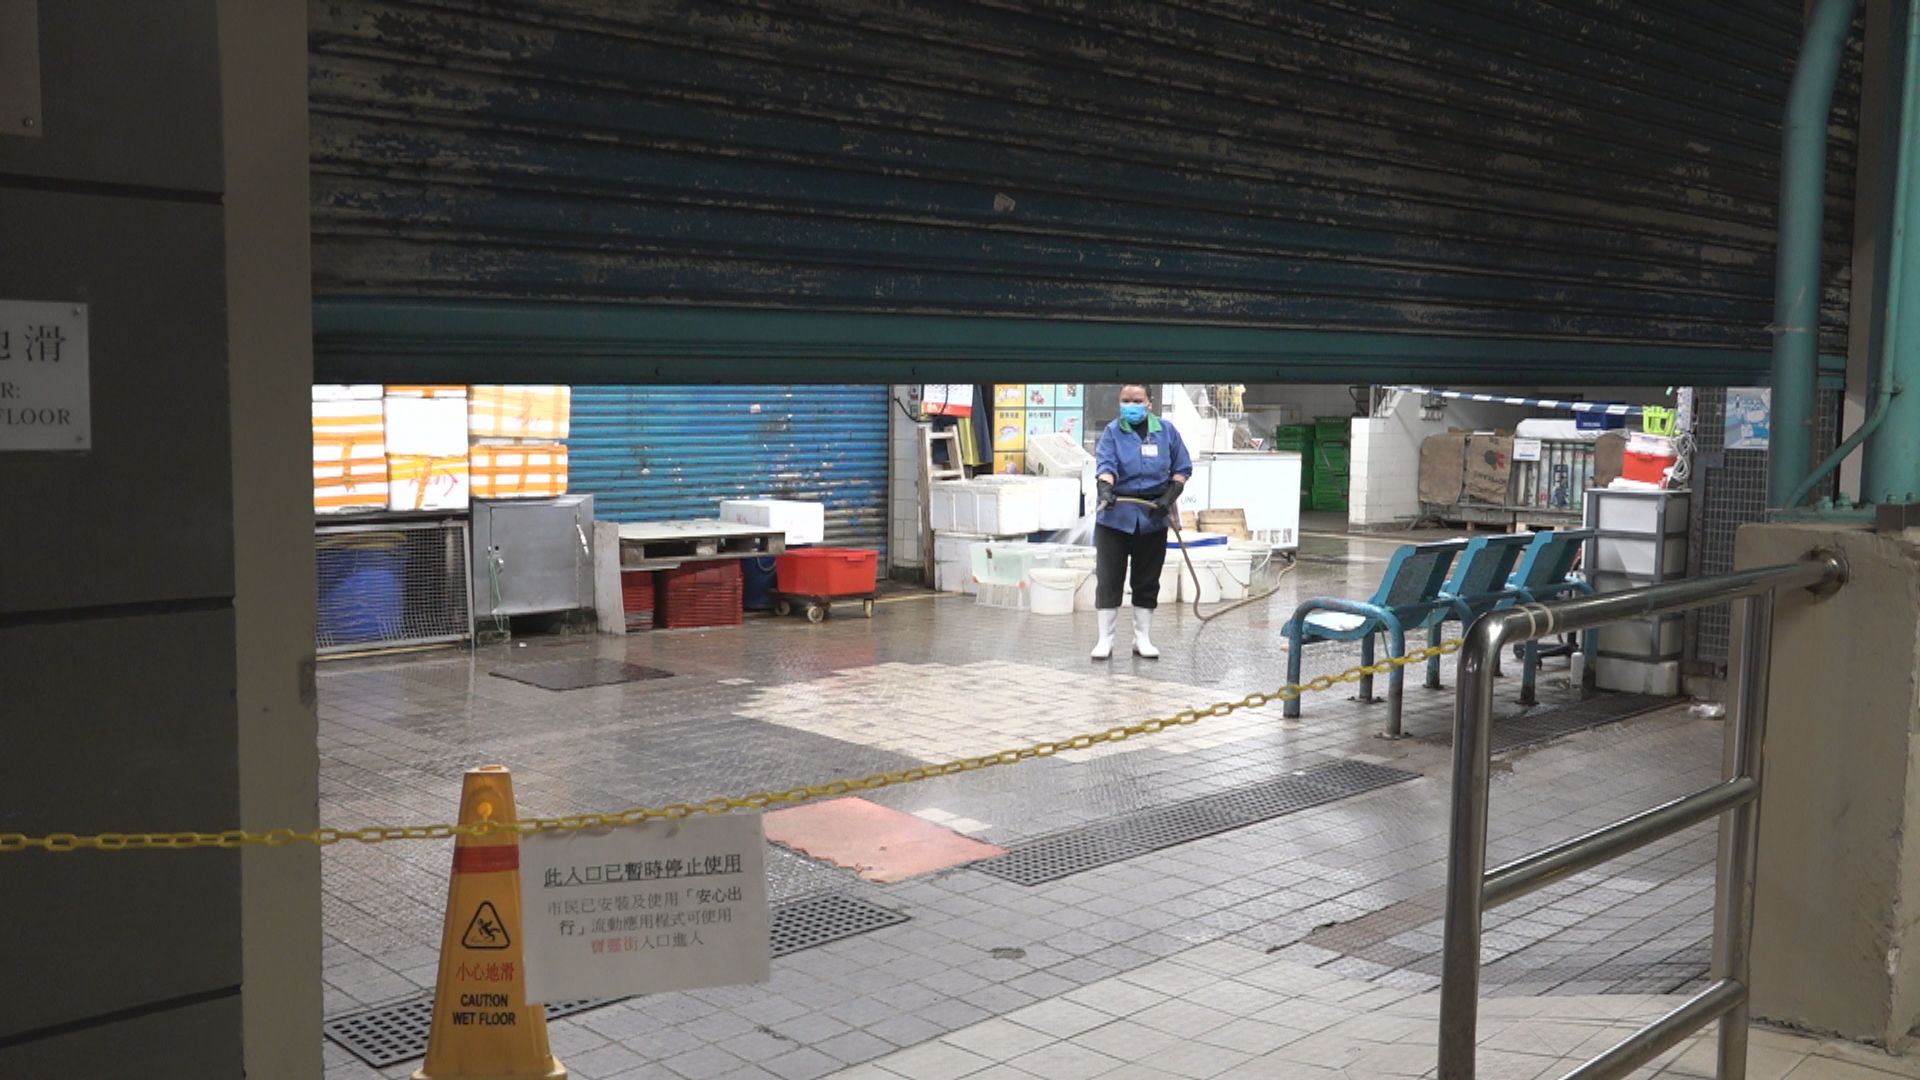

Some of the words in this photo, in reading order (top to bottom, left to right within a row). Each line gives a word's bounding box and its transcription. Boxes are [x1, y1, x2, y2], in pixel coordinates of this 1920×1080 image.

[544, 854, 743, 887] 此入口已暫時停止使用
[456, 961, 514, 983] 小心地滑
[460, 994, 508, 1007] CAUTION
[452, 1012, 475, 1025] WET
[479, 1012, 516, 1025] FLOOR
